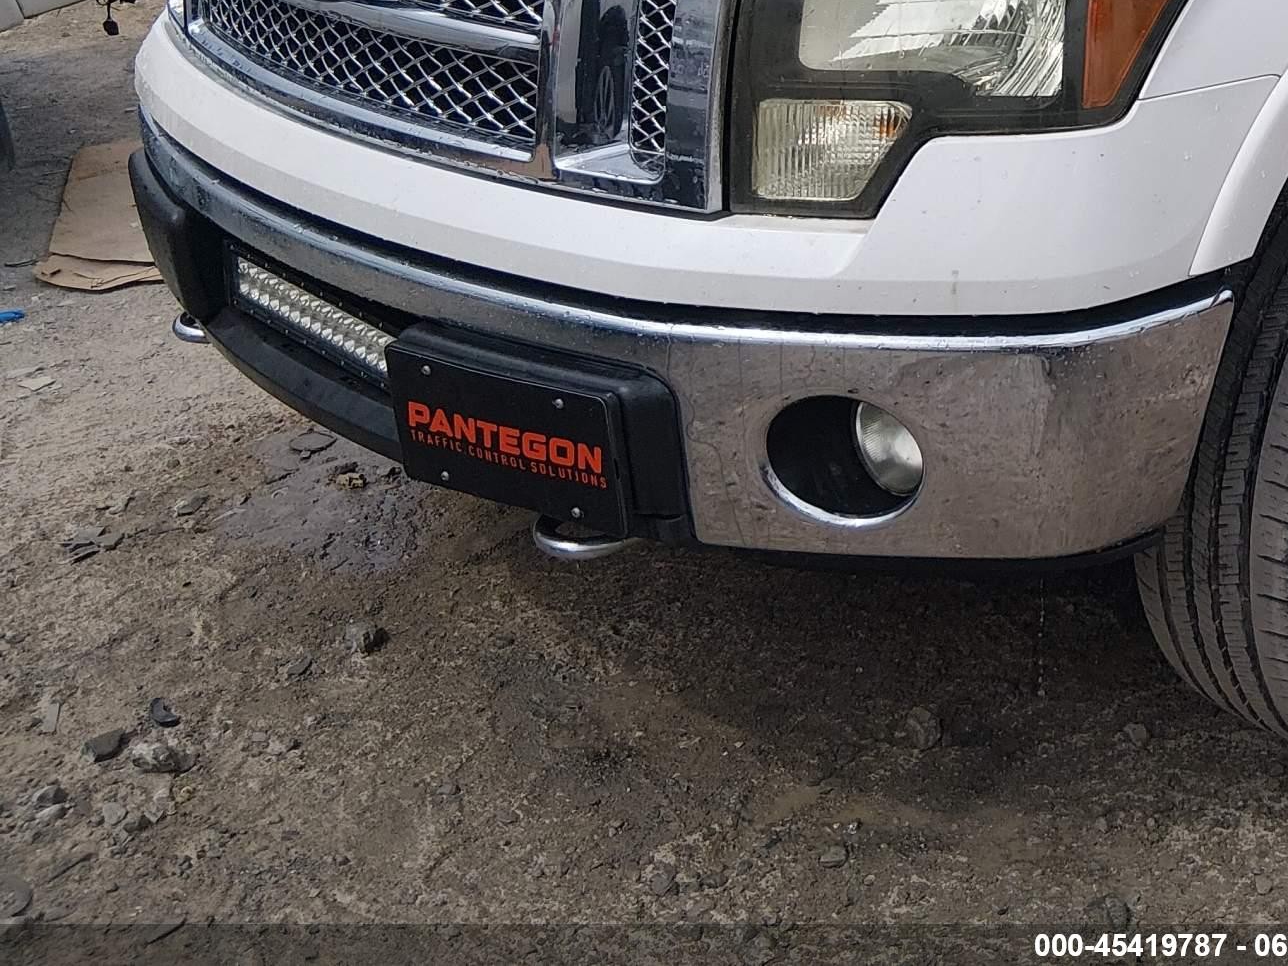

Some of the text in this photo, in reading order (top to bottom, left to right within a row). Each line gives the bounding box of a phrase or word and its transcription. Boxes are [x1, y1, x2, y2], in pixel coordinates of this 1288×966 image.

[407, 401, 603, 475] PANTEGON
[410, 429, 608, 489] TRAFFIC CONTROL SOLUTIONS
